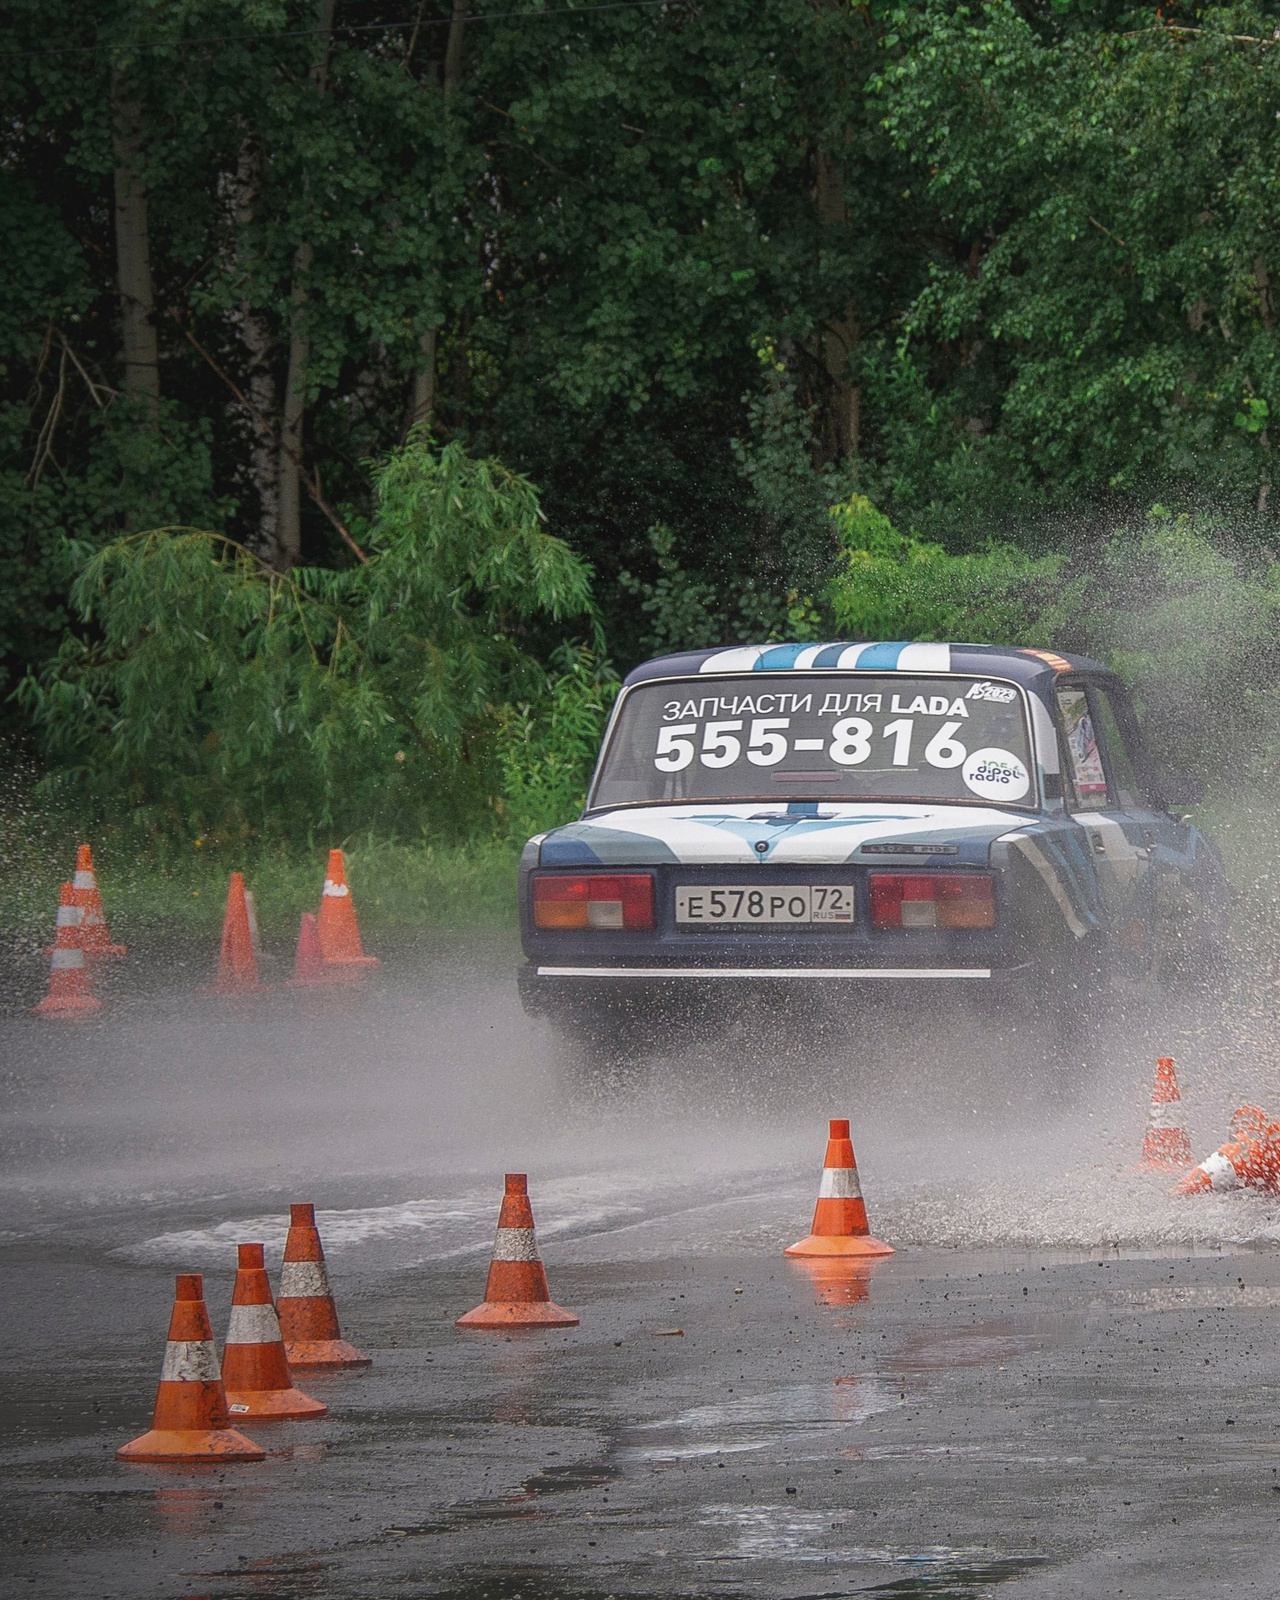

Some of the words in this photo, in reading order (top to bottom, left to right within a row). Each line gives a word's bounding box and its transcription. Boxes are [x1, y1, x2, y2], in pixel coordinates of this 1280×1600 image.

[662, 693, 813, 720] ЗАПЧАСТИ
[818, 693, 882, 716] ДЛЯ
[891, 694, 969, 718] LADA
[654, 717, 967, 773] 555-816
[969, 773, 1010, 784] radio
[815, 889, 843, 910] 72
[813, 911, 834, 919] RUS
